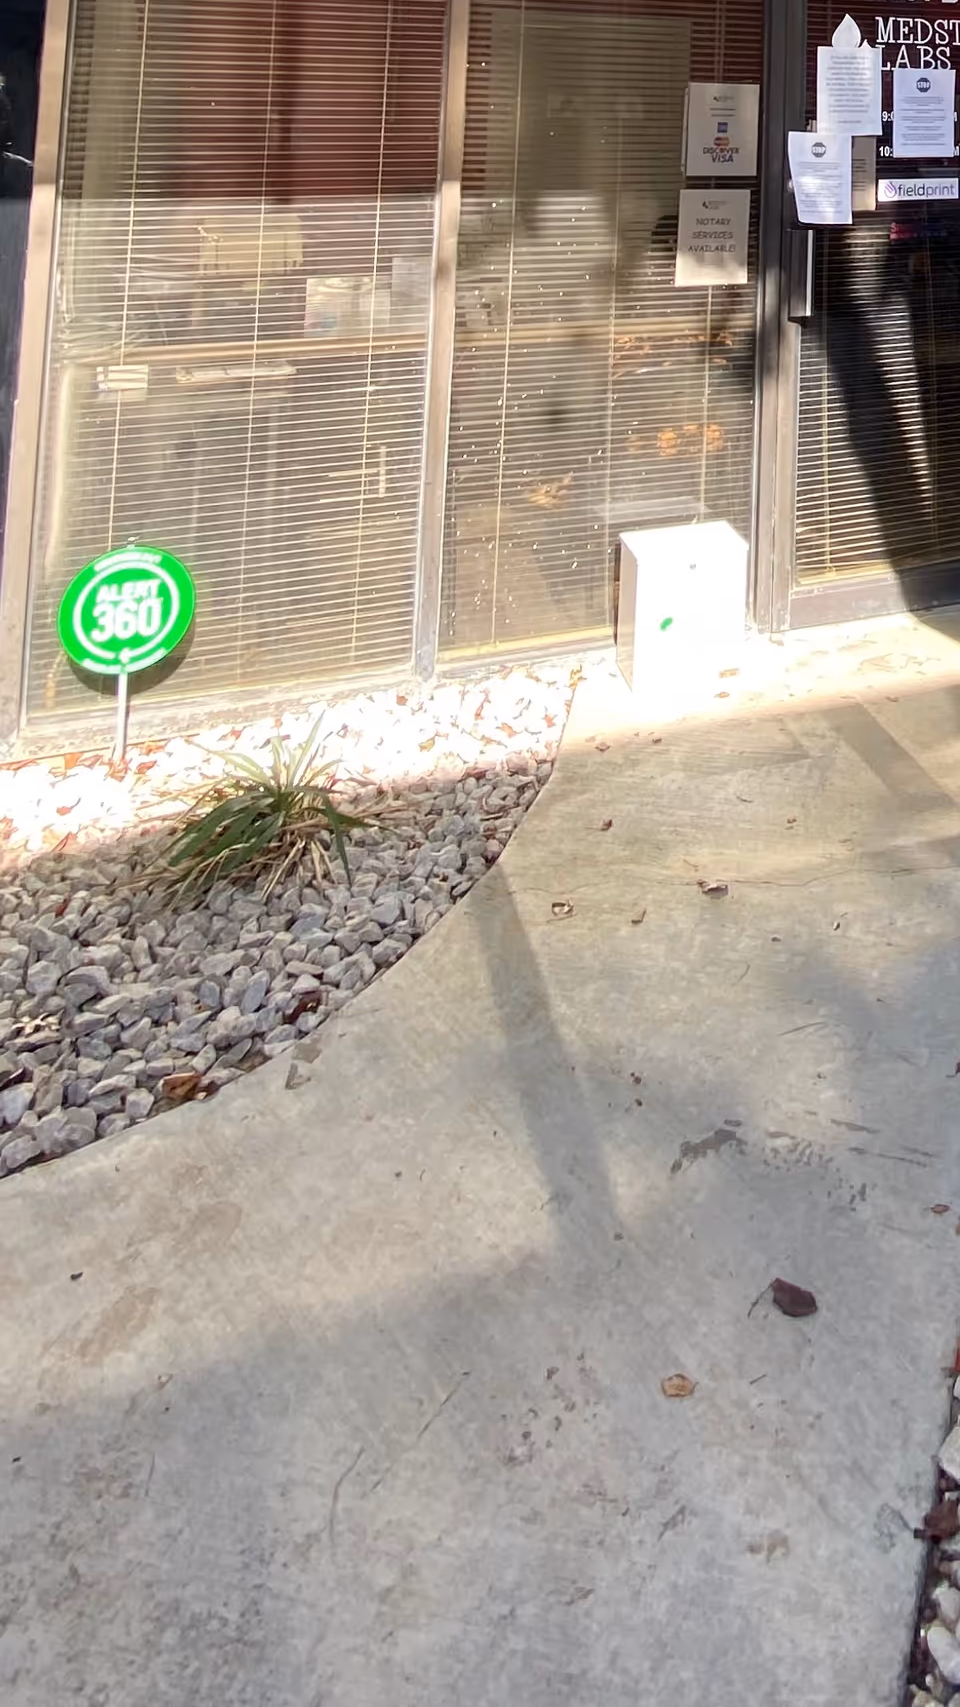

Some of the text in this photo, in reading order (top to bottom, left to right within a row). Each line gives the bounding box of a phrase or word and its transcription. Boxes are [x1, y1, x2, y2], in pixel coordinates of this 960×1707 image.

[875, 44, 951, 70] LABS
[917, 81, 931, 89] STOP
[703, 147, 740, 155] DISCOVER
[811, 146, 826, 154] STOP
[711, 154, 734, 163] VISA
[898, 183, 955, 198] fieldprint
[696, 218, 732, 226] NOTARY
[692, 231, 734, 239] SERVICES
[96, 578, 161, 602] ALERT
[91, 598, 162, 642] 360
